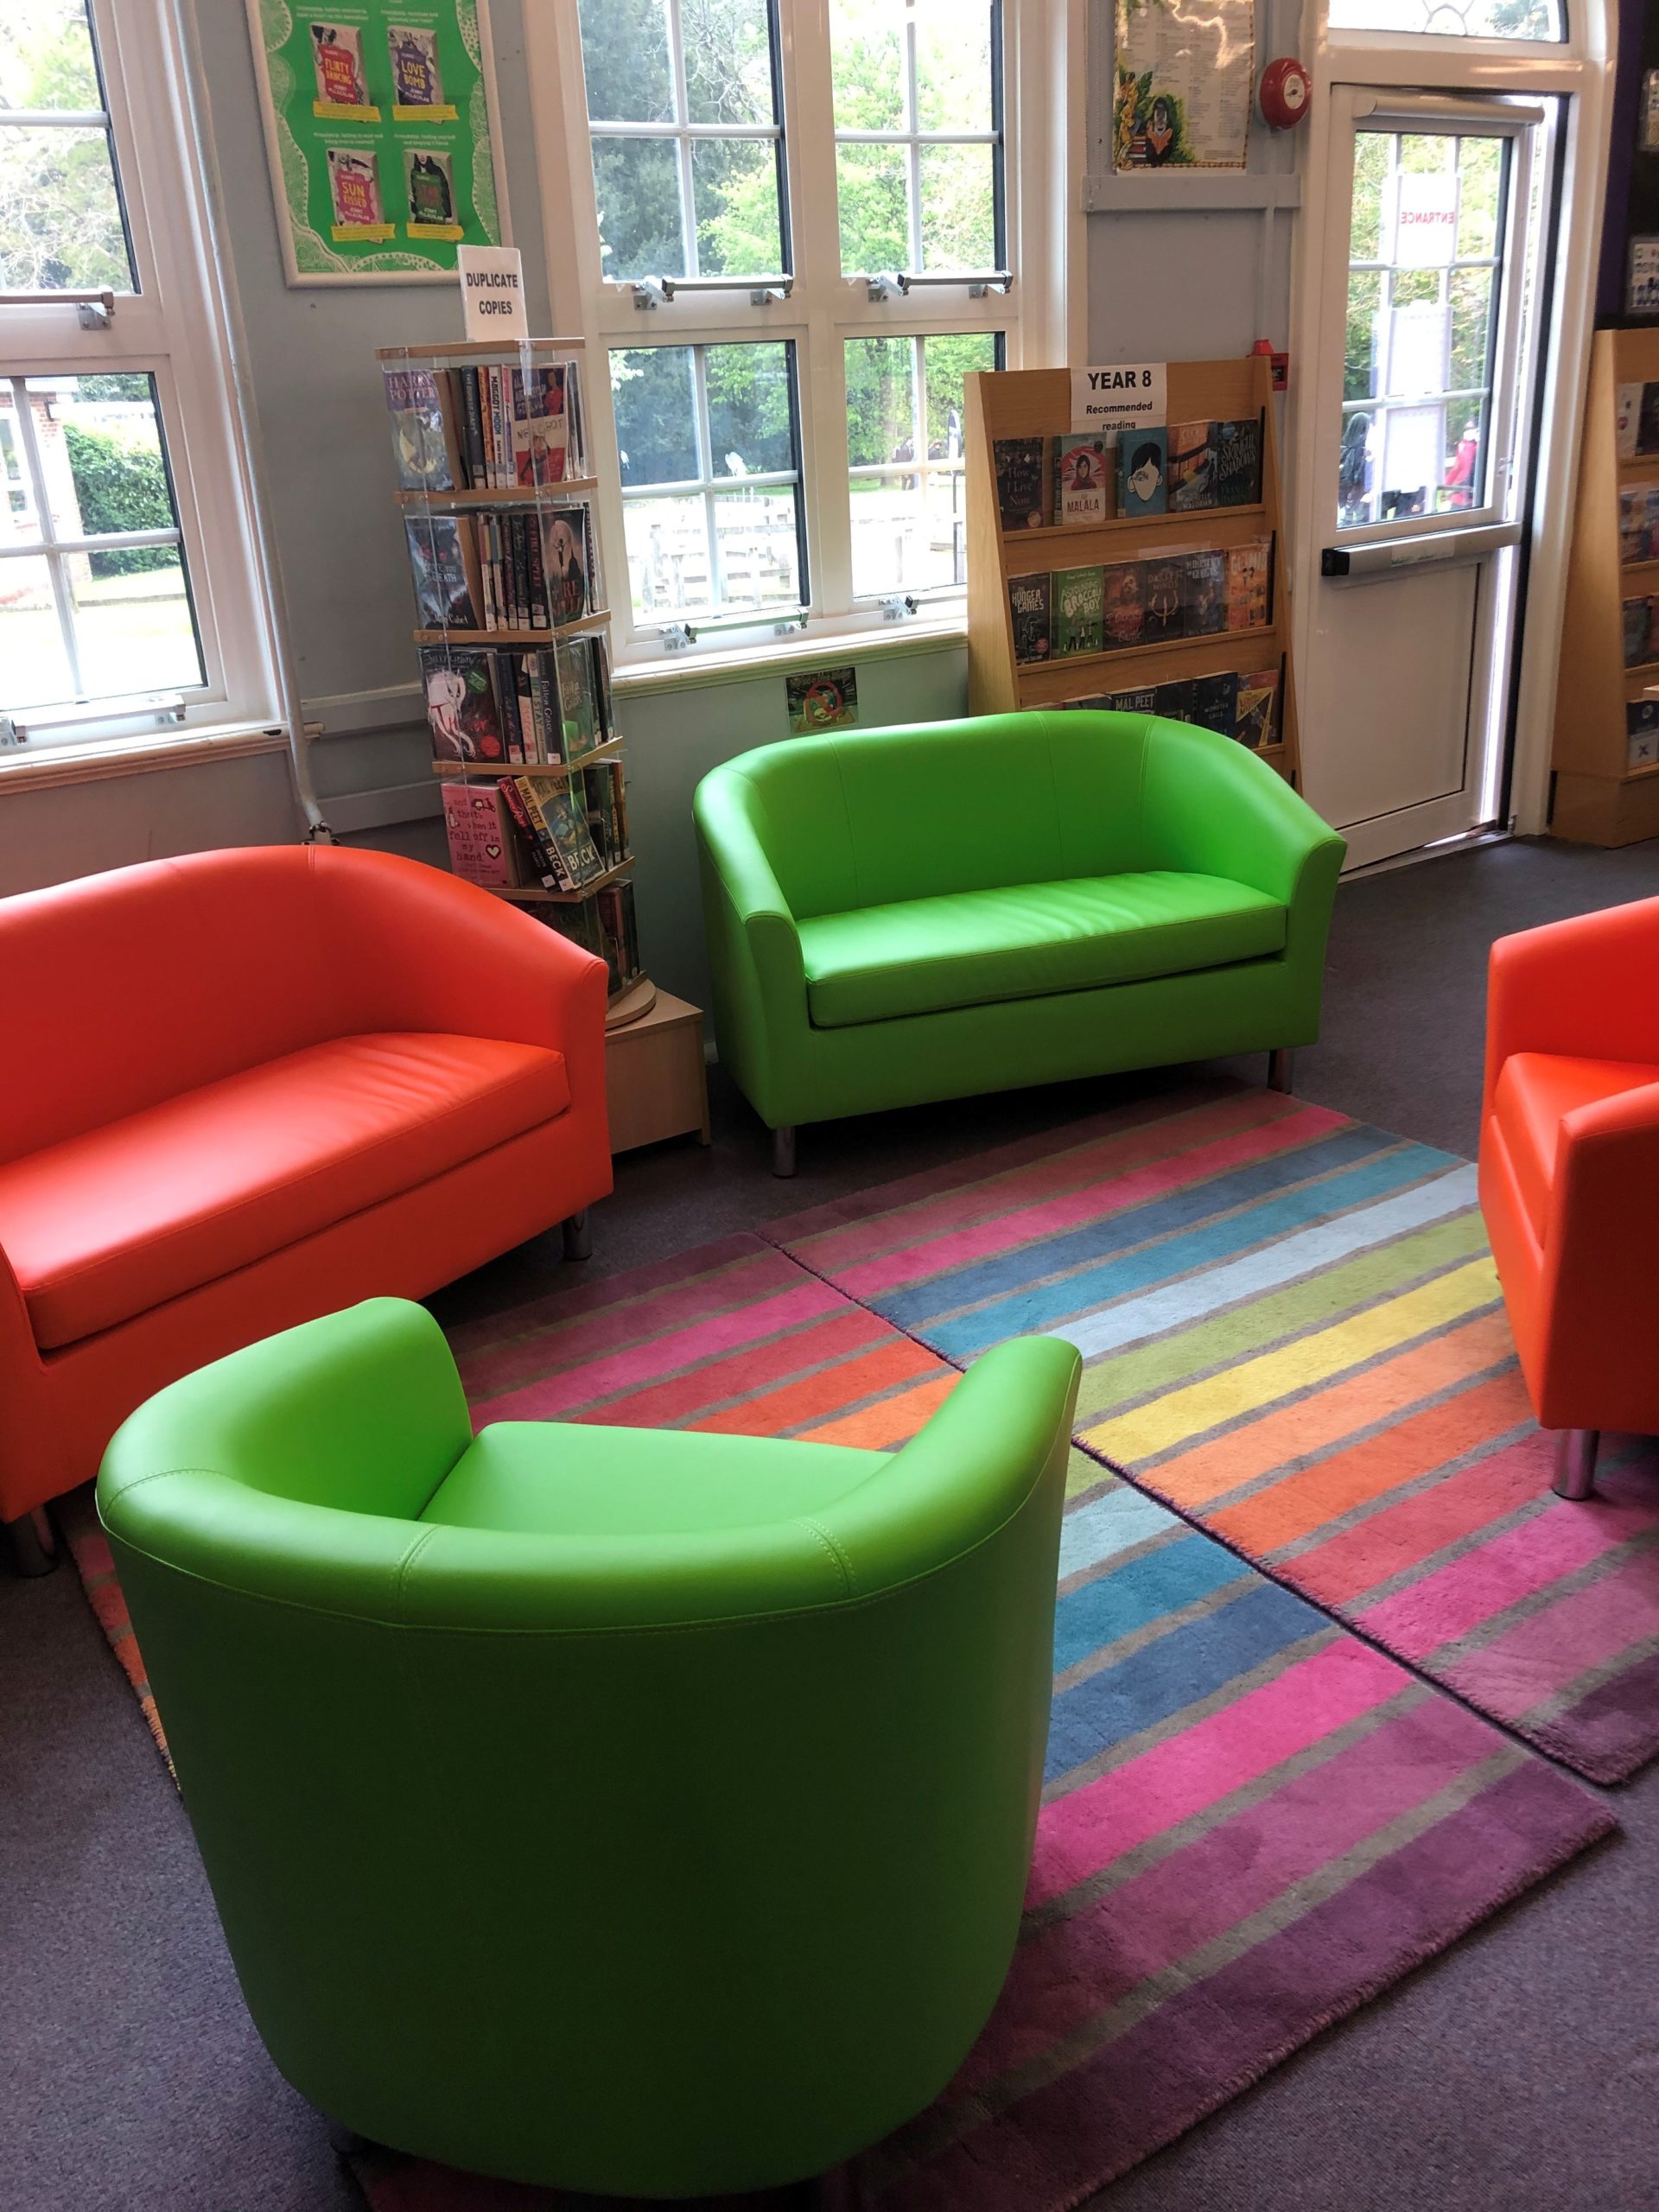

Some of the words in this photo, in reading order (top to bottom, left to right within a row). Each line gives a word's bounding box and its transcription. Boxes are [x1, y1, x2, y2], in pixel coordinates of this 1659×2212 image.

[401, 60, 425, 78] LOVE
[404, 74, 425, 89] BOMB
[341, 181, 365, 197] SUN
[466, 272, 518, 288] DUPLICATE
[479, 300, 512, 315] COPIES
[388, 372, 432, 389] HARRY
[1087, 371, 1136, 391] YEAR
[1142, 370, 1152, 387] 8
[491, 376, 500, 410] MAGGOT
[1085, 401, 1153, 415] Recommended
[493, 411, 502, 435] MOON
[1102, 421, 1136, 430] reading
[1007, 467, 1030, 478] How
[1014, 481, 1033, 493] Live
[1009, 495, 1030, 506] Now
[1067, 499, 1099, 512] MALALA
[1012, 588, 1041, 606] HUNGER
[1064, 588, 1102, 618] BROCCOLI
[1084, 597, 1101, 614] BOY
[1018, 599, 1045, 613] GAMES
[541, 680, 550, 705] Fallen
[1116, 697, 1133, 710] MAL
[1135, 693, 1154, 709] PEET
[533, 701, 543, 727] STAY
[543, 708, 553, 734] Grace
[449, 830, 471, 841] fell
[473, 831, 488, 842] off
[519, 787, 532, 806] MAL
[528, 804, 543, 825] PEET
[545, 846, 566, 878] BECK
